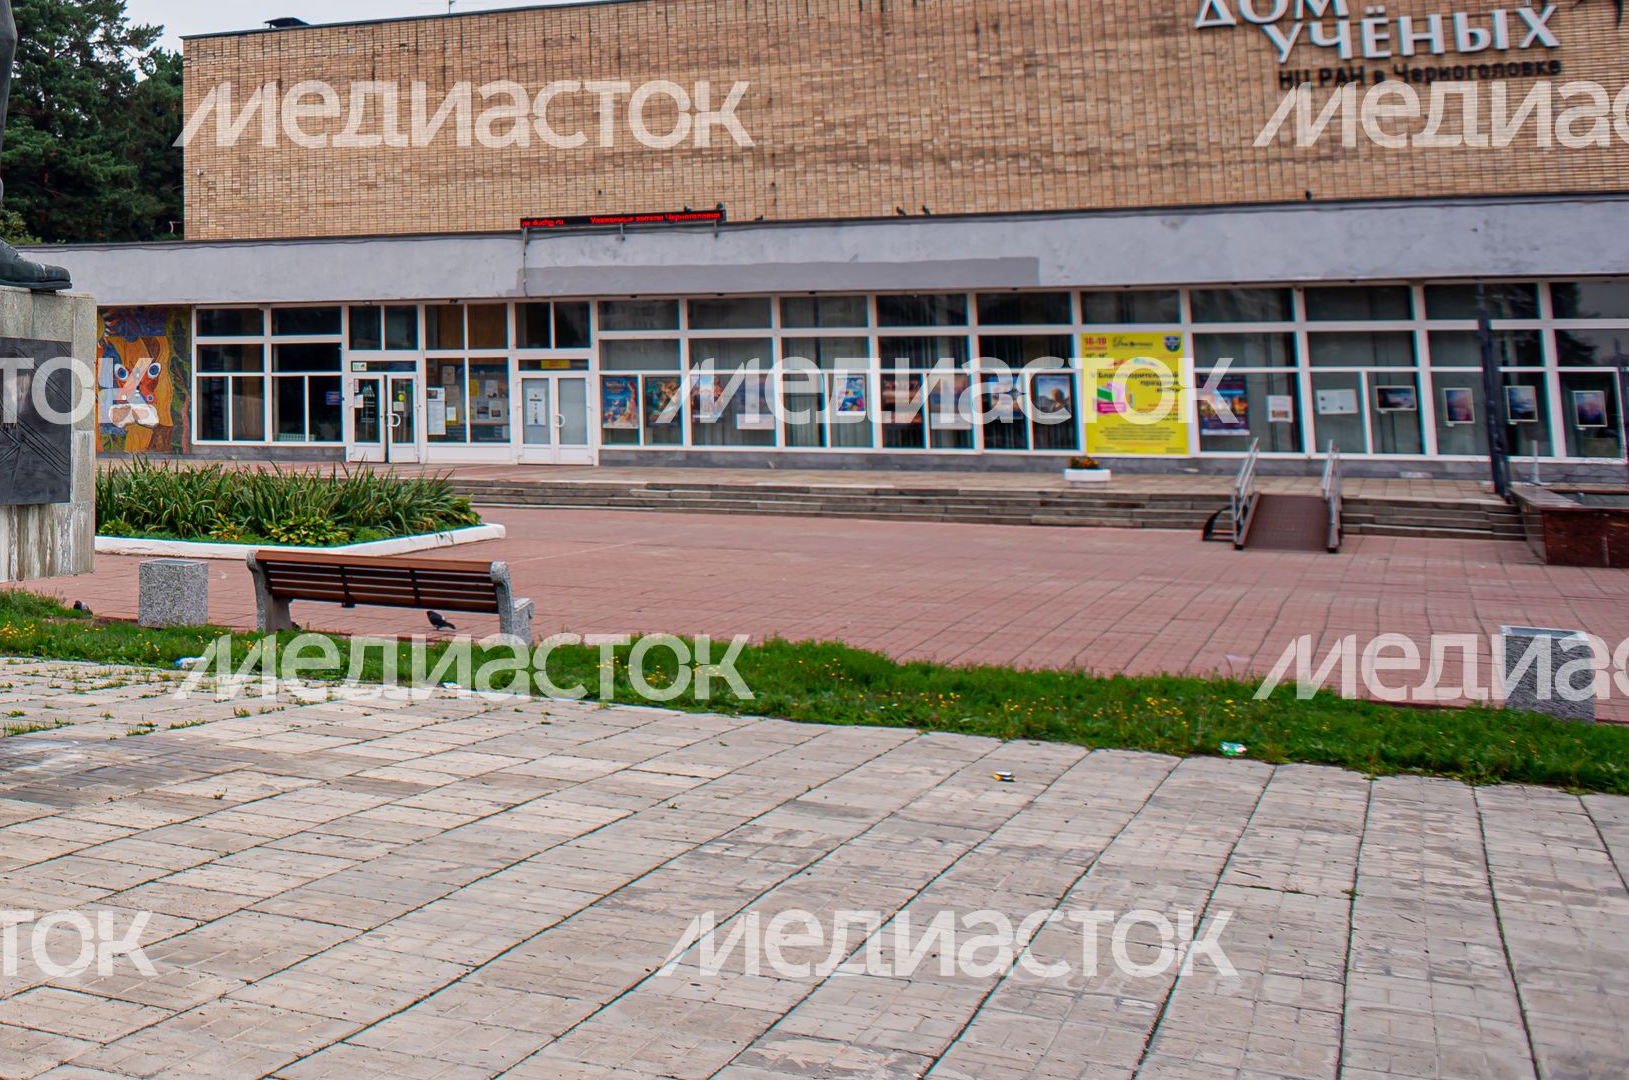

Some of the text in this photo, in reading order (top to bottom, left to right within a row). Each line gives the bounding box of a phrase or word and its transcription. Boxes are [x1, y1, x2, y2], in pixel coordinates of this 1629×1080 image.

[1261, 5, 1560, 63] УЧЁНЫХ
[1320, 66, 1364, 87] РАН
[1394, 60, 1562, 84] Черноголовке
